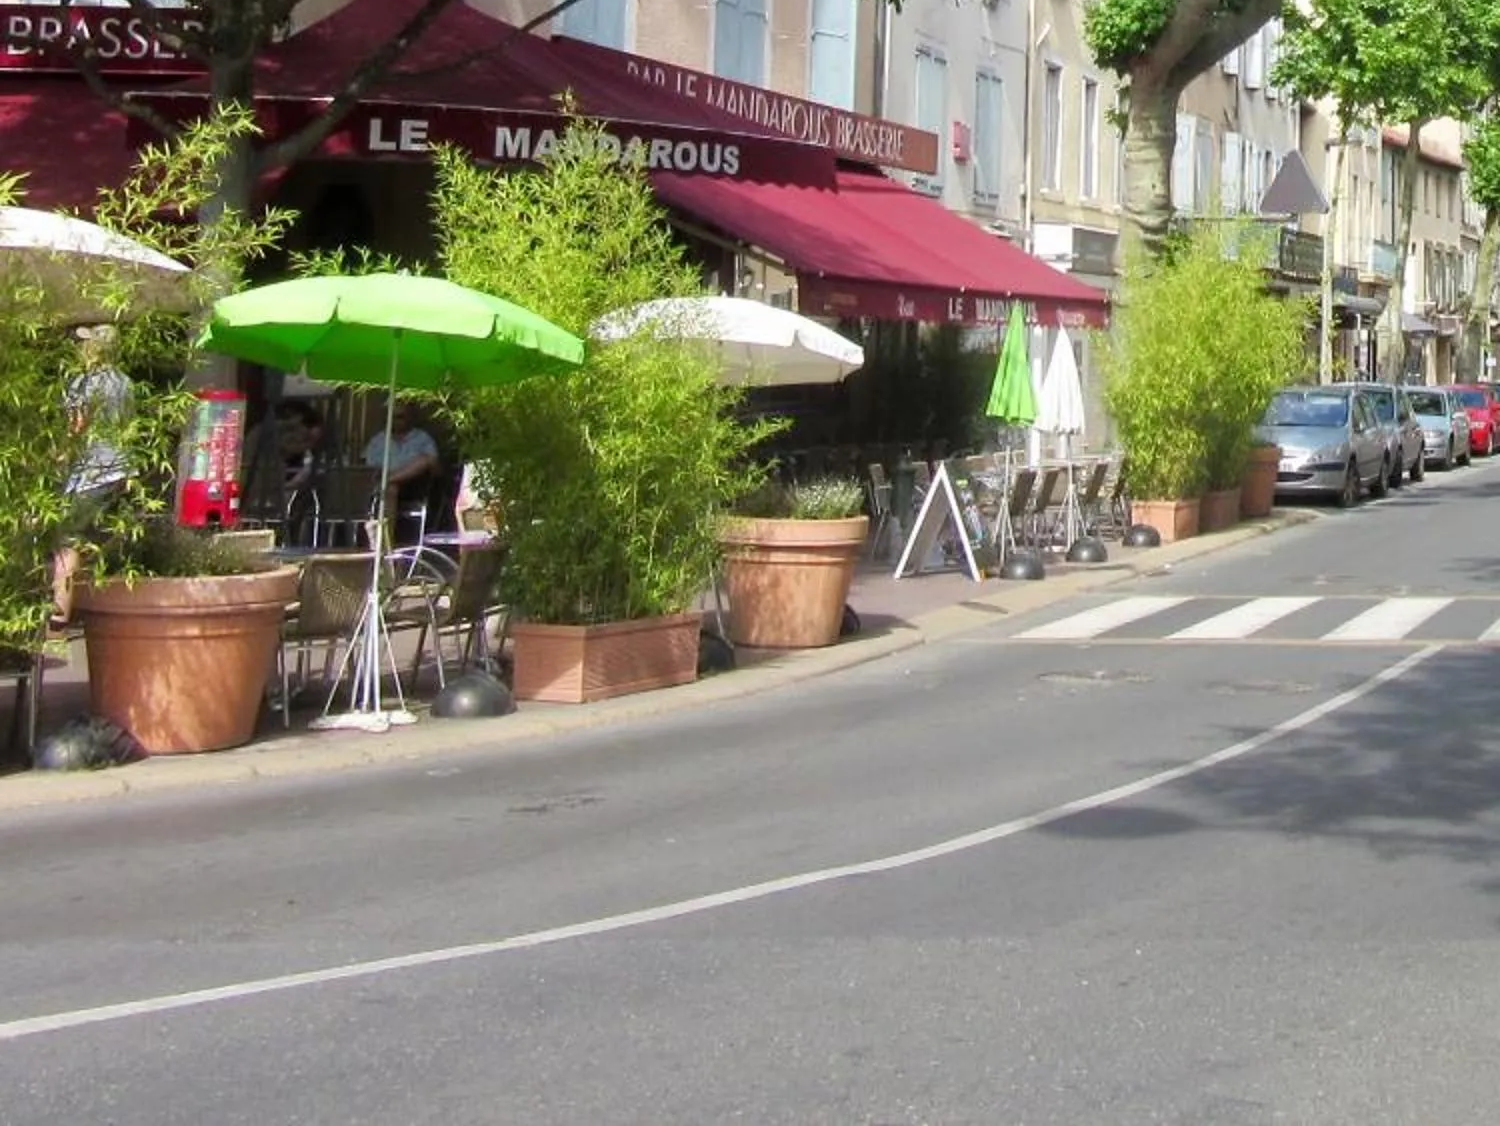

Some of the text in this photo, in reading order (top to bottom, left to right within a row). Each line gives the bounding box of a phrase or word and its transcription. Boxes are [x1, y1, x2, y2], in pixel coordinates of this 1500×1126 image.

[368, 117, 430, 151] LE
[834, 115, 906, 163] BRASSERIE
[948, 297, 963, 321] LE
